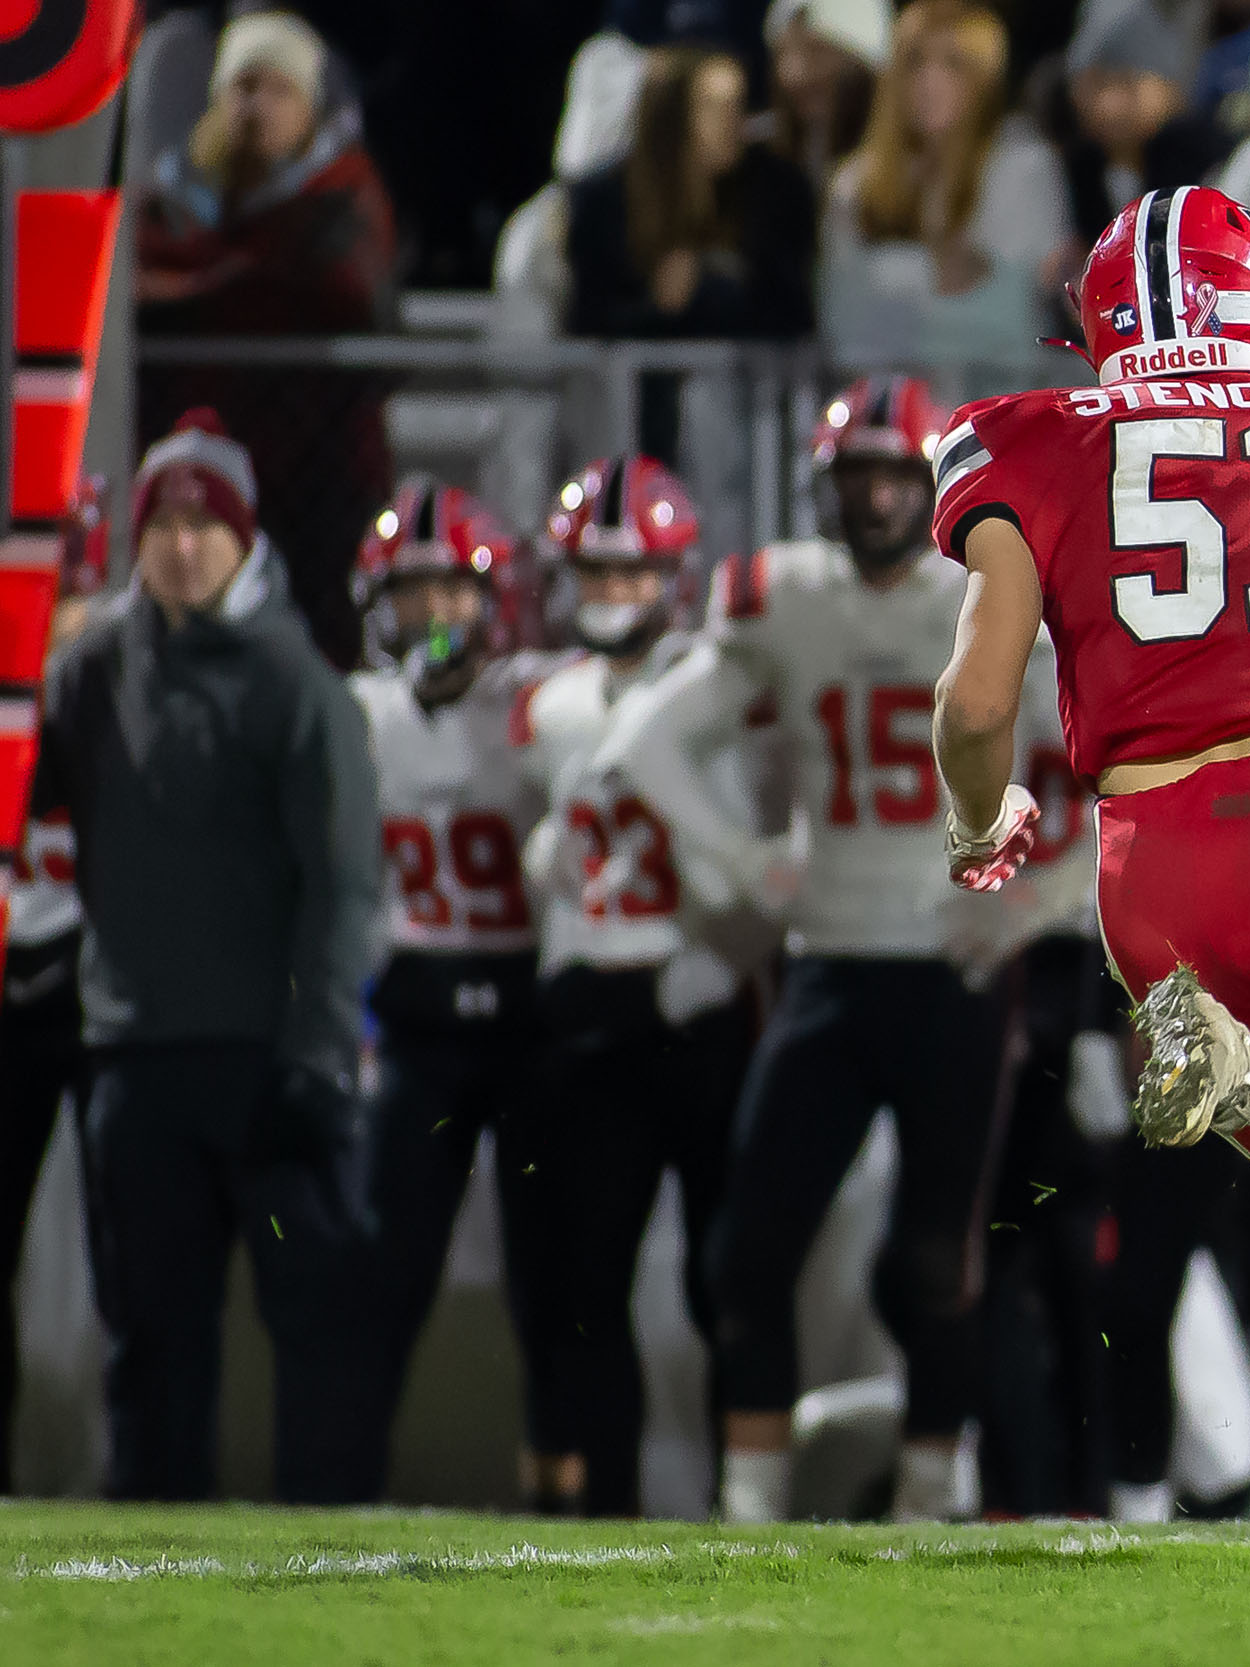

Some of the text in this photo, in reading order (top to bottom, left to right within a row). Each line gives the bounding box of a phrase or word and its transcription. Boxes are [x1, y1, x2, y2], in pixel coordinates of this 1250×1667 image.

[1114, 309, 1136, 330] JK
[1120, 343, 1228, 379] Riddell
[818, 684, 940, 825] 15
